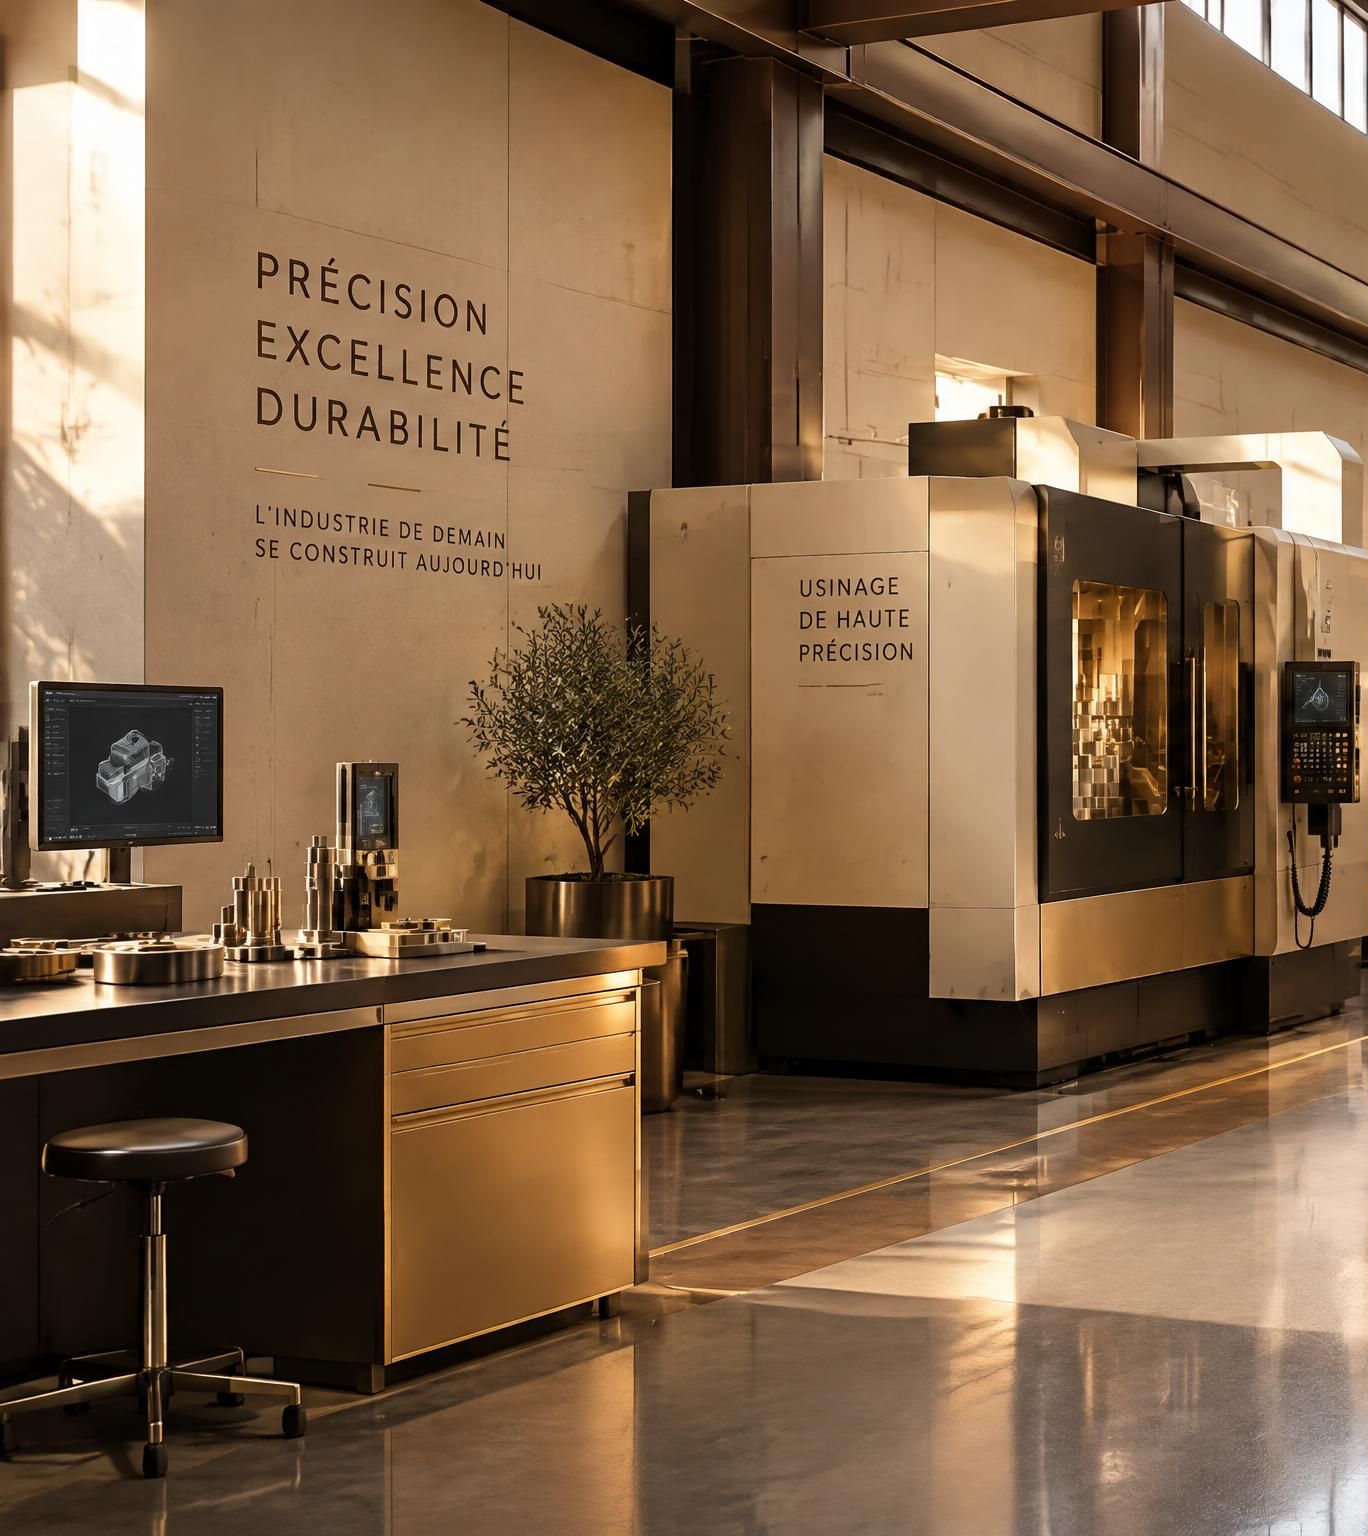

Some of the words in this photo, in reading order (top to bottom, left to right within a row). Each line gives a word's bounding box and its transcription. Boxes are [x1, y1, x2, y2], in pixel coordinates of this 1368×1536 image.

[257, 252, 488, 335] PRÉCISION
[257, 320, 524, 404] EXCELLENCE
[257, 387, 510, 461] DURABILITÉ
[256, 505, 389, 536] L'INDUSTRIE
[399, 522, 422, 540] DE
[433, 526, 505, 549] DEMAIN
[255, 539, 278, 558] SE
[290, 542, 407, 569] CONSTRUIT
[416, 554, 541, 580] AUJOURD'HUI
[800, 577, 898, 597] USINAGE
[800, 611, 826, 629] DE
[838, 609, 909, 628] HAUTE
[800, 639, 912, 662] PRÉCISION
